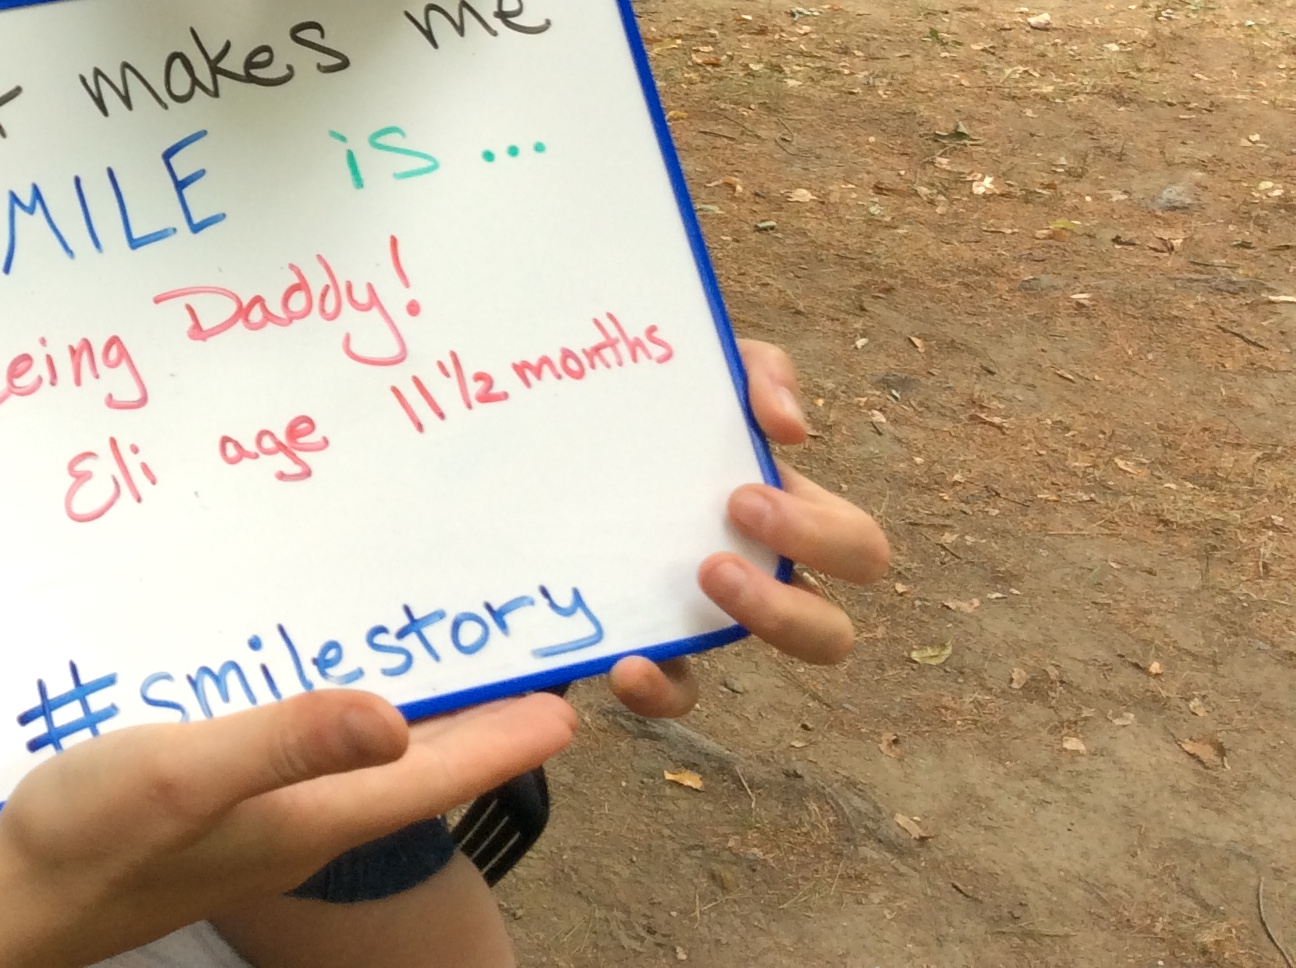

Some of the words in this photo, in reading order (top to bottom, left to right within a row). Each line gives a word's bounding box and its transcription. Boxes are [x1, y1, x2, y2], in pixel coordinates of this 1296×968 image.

[79, 21, 351, 111] makes
[153, 234, 422, 367] Daddy!
[63, 440, 157, 523] Eli
[219, 415, 330, 482] age
[511, 311, 674, 390] months
[16, 584, 604, 755] #smilestory
